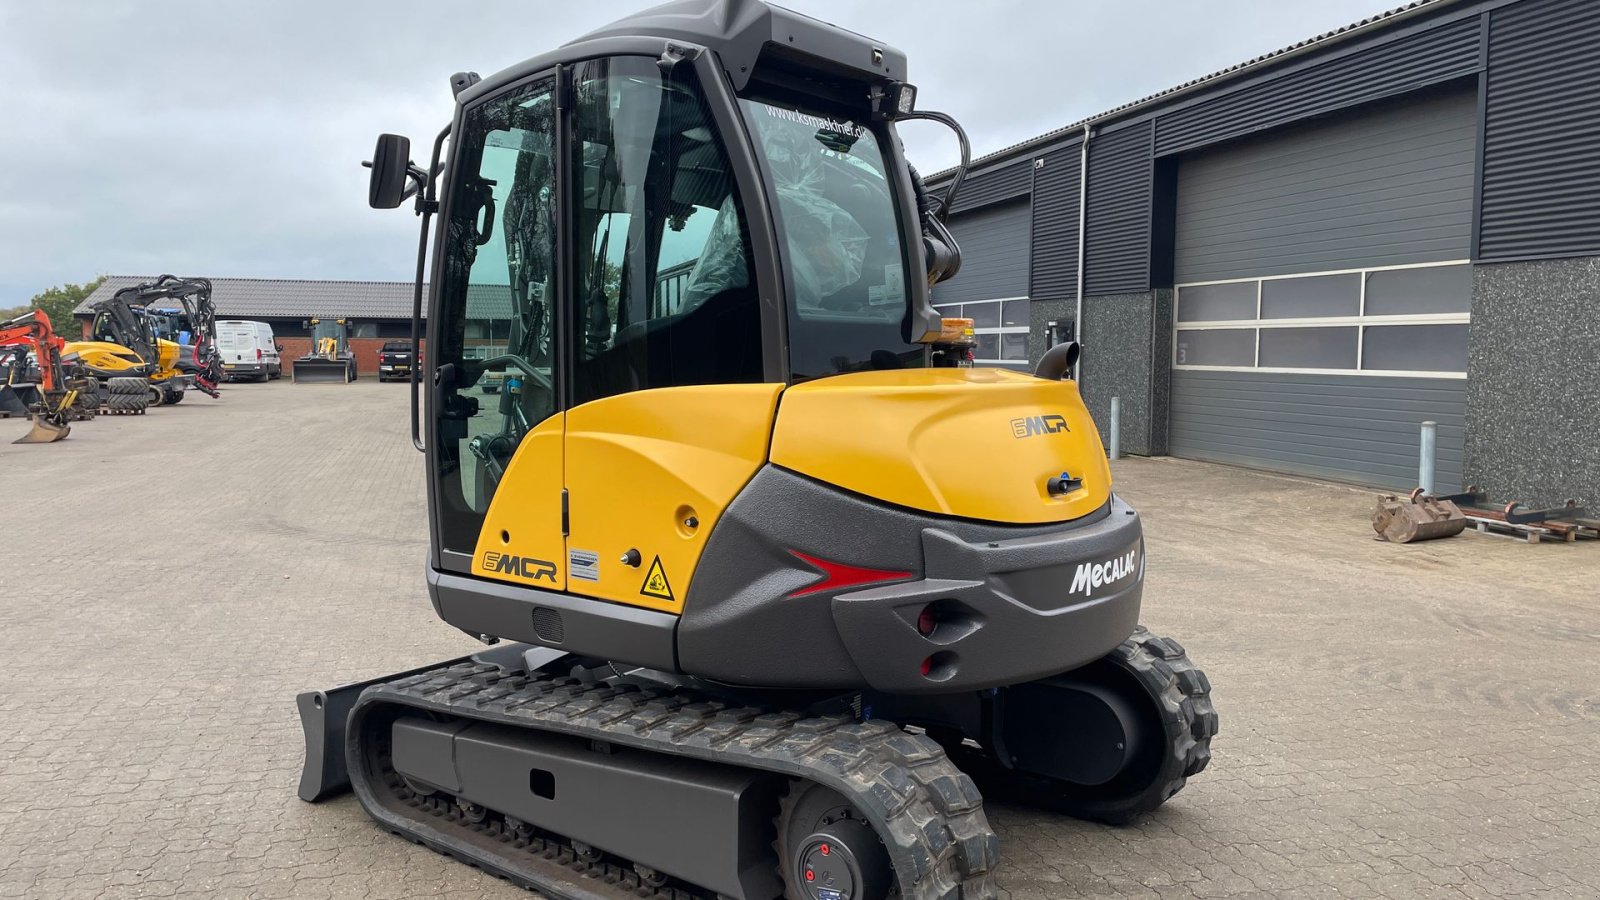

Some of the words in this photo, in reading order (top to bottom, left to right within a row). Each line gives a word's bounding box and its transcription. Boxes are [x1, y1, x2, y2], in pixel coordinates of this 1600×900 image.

[764, 105, 869, 139] www.ksmaskiner.dk
[1010, 414, 1071, 439] 6MCR
[482, 551, 557, 583] 6MCR
